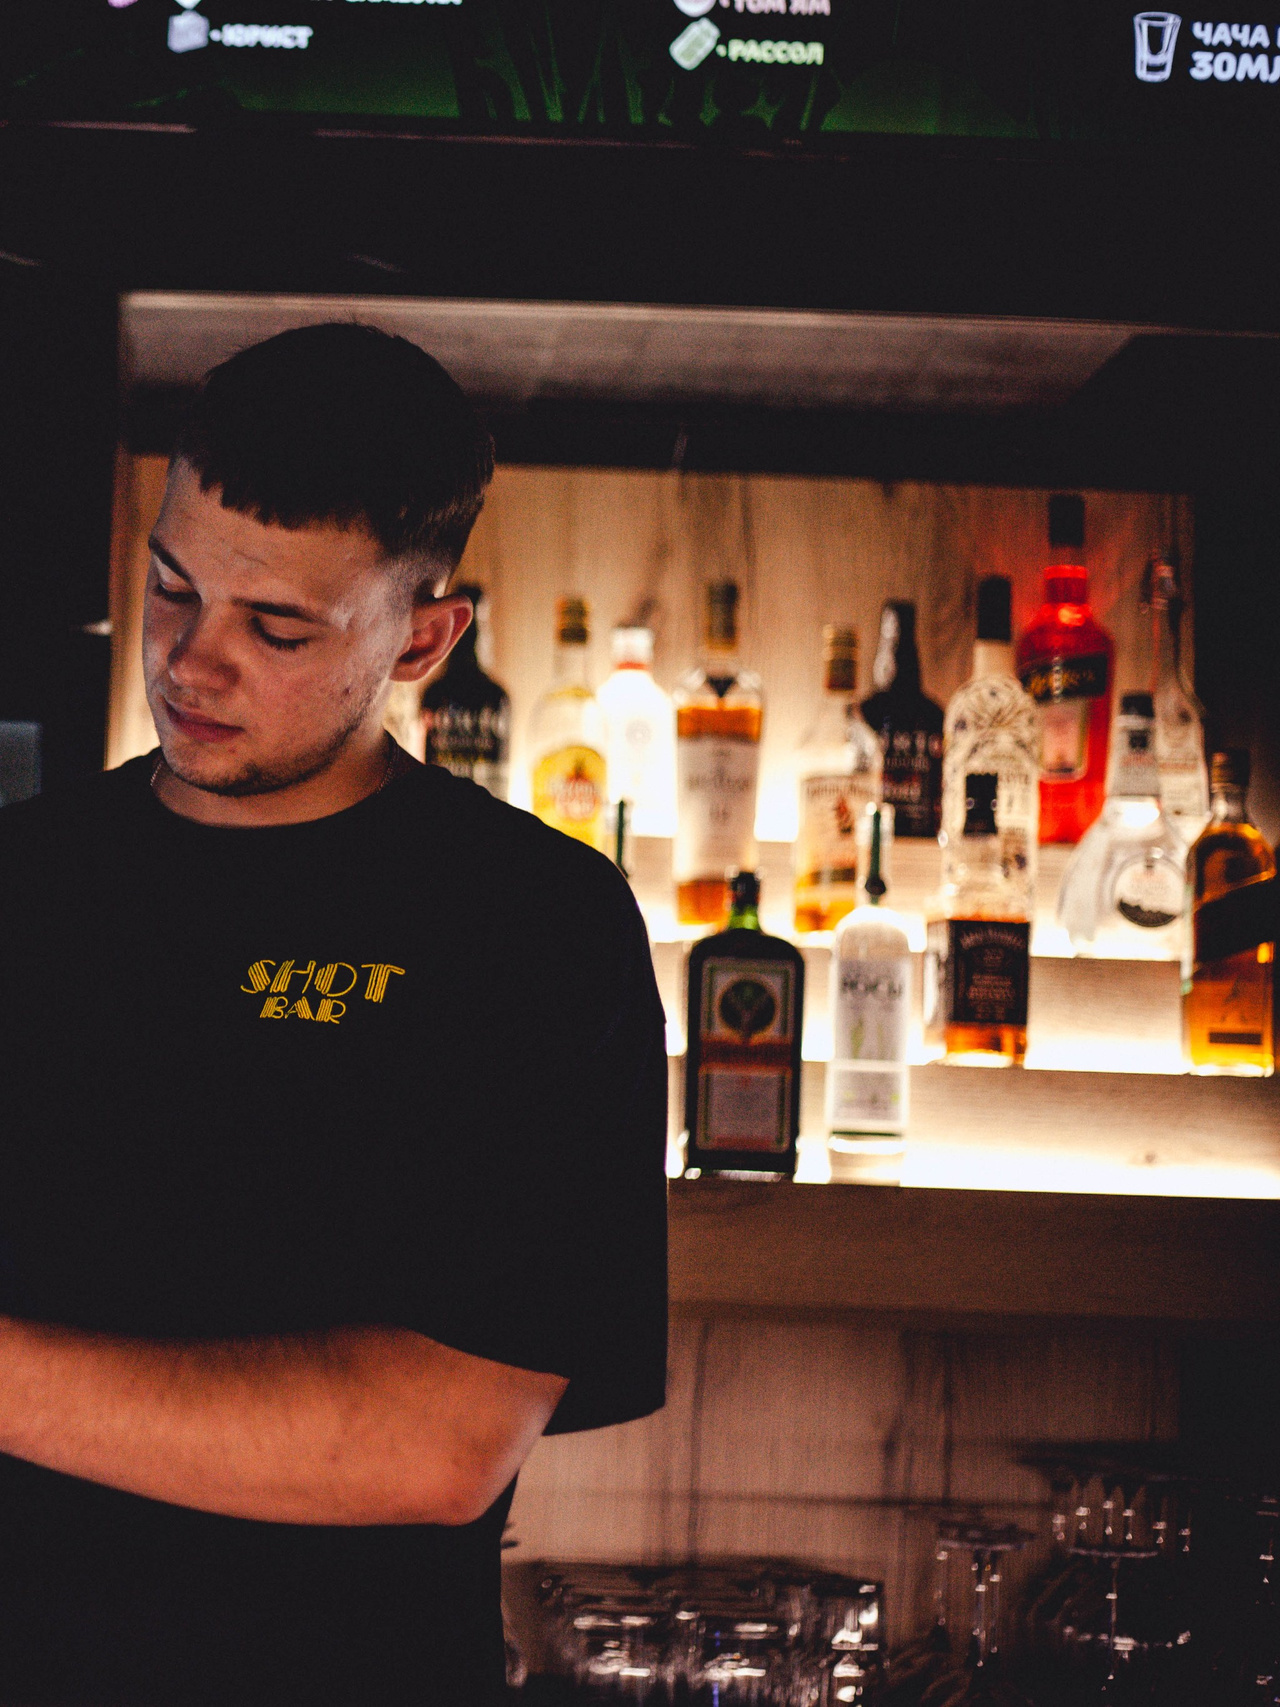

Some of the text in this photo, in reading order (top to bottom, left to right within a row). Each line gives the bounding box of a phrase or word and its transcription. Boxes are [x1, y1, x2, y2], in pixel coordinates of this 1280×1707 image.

[1192, 21, 1271, 48] ЧАЧА
[728, 38, 824, 65] РАССОЛ
[240, 959, 406, 1003] SHOT
[259, 995, 347, 1024] BAR
